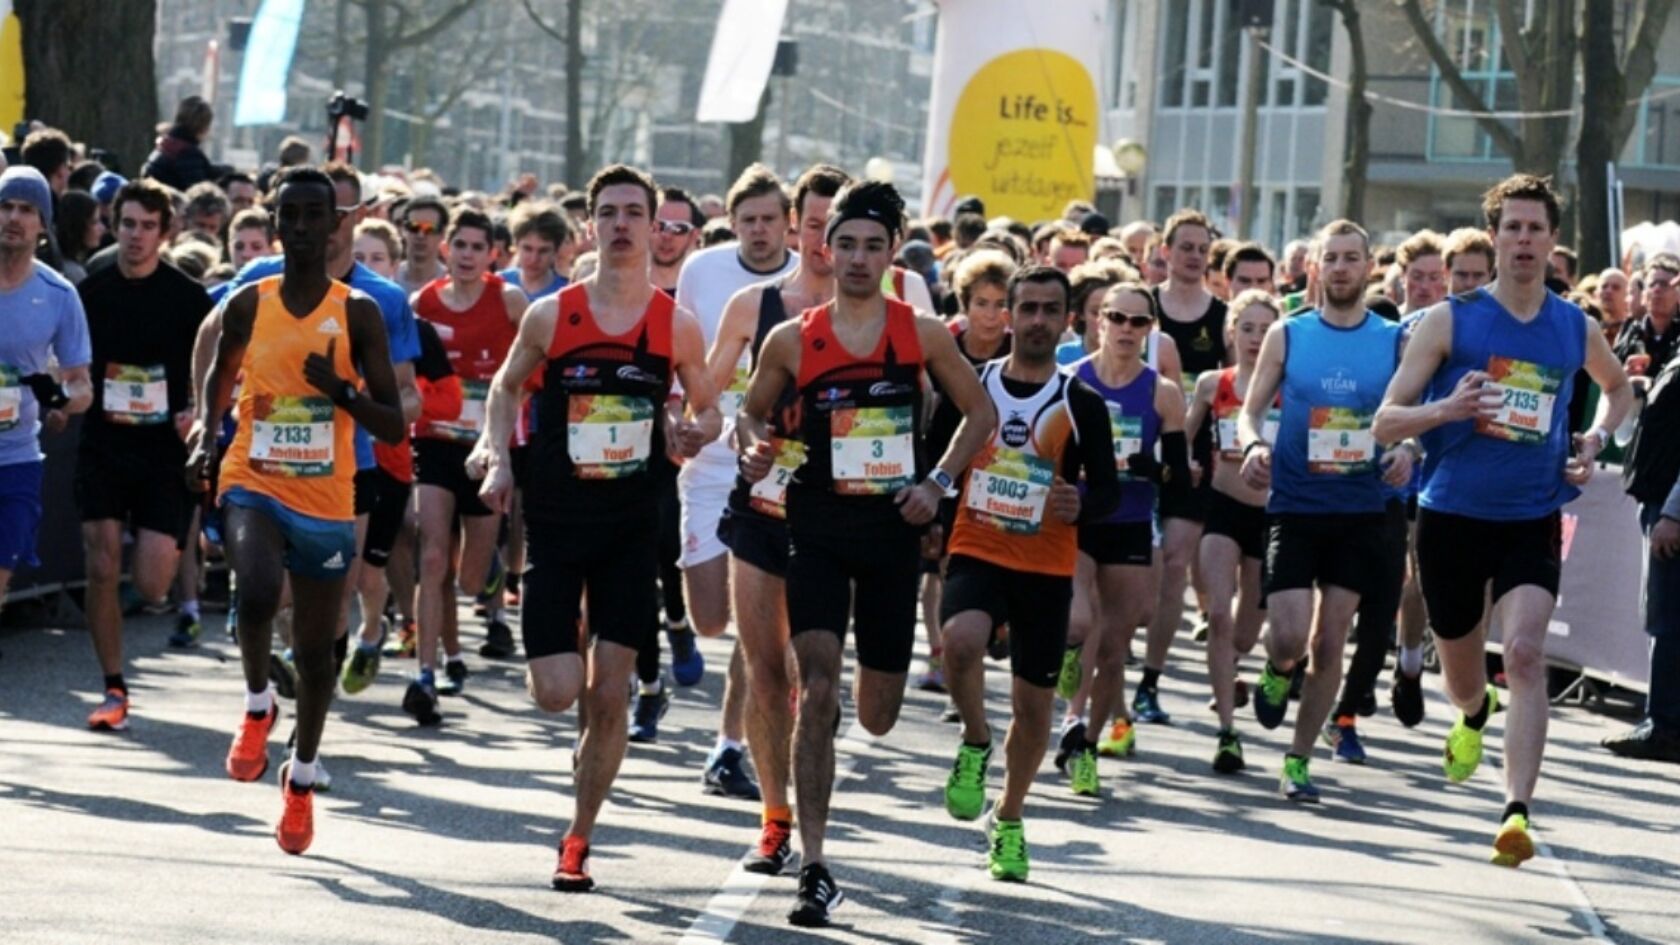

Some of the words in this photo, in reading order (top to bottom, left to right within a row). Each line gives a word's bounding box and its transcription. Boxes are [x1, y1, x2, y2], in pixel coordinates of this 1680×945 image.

[1000, 95, 1048, 121] Life
[984, 134, 1058, 171] jezelf
[991, 170, 1076, 212] uitdagen
[1321, 377, 1357, 393] VEGAN
[1504, 388, 1539, 412] 2135
[273, 426, 312, 445] 2133
[609, 426, 617, 444] 1
[1004, 424, 1027, 433] SPORT
[872, 439, 883, 458] 3
[987, 476, 1029, 501] 3003
